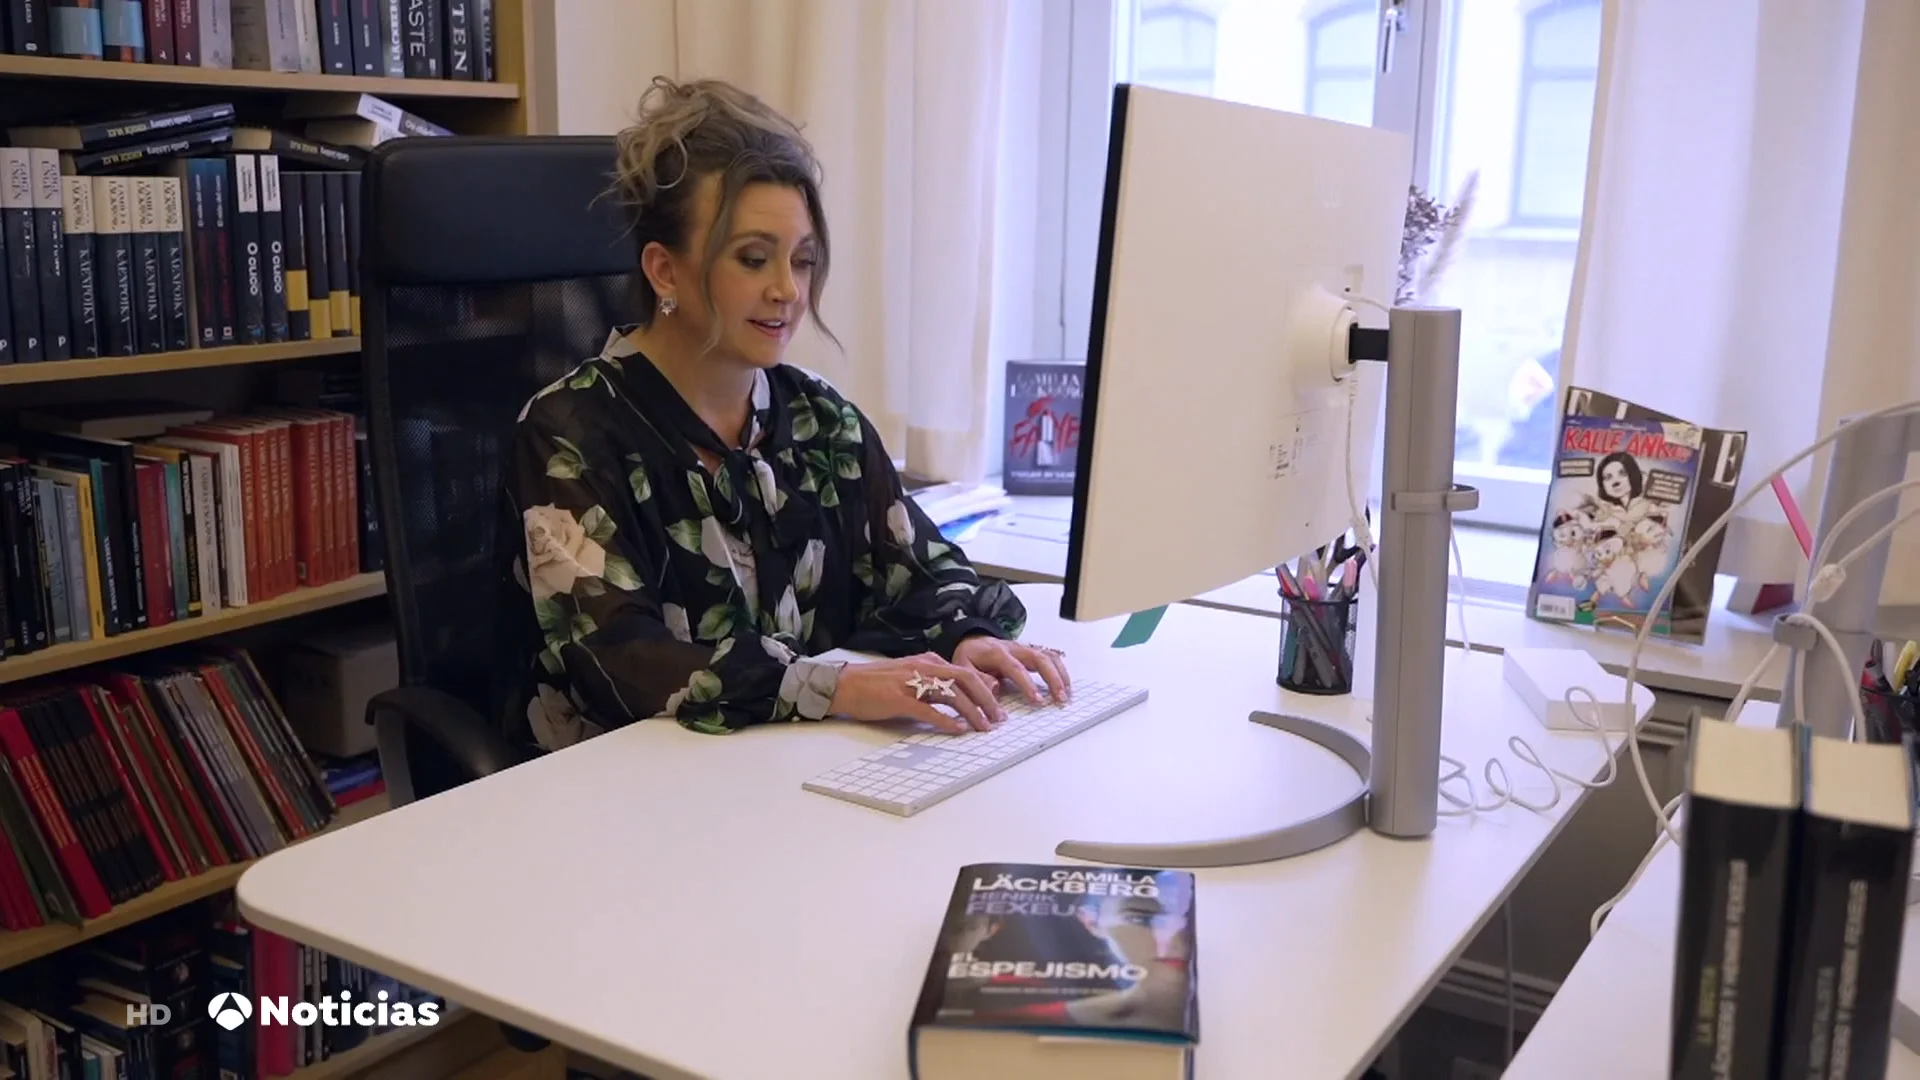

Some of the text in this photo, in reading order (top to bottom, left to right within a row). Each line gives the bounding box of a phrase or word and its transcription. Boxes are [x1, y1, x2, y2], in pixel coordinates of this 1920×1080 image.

[1564, 428, 1623, 453] KALLE
[972, 874, 1160, 898] LÄCKBERG
[1051, 870, 1157, 885] CAMILLA
[969, 893, 1056, 903] HENRIK
[951, 952, 979, 964] EL
[948, 961, 1149, 981] ESPEJISMO
